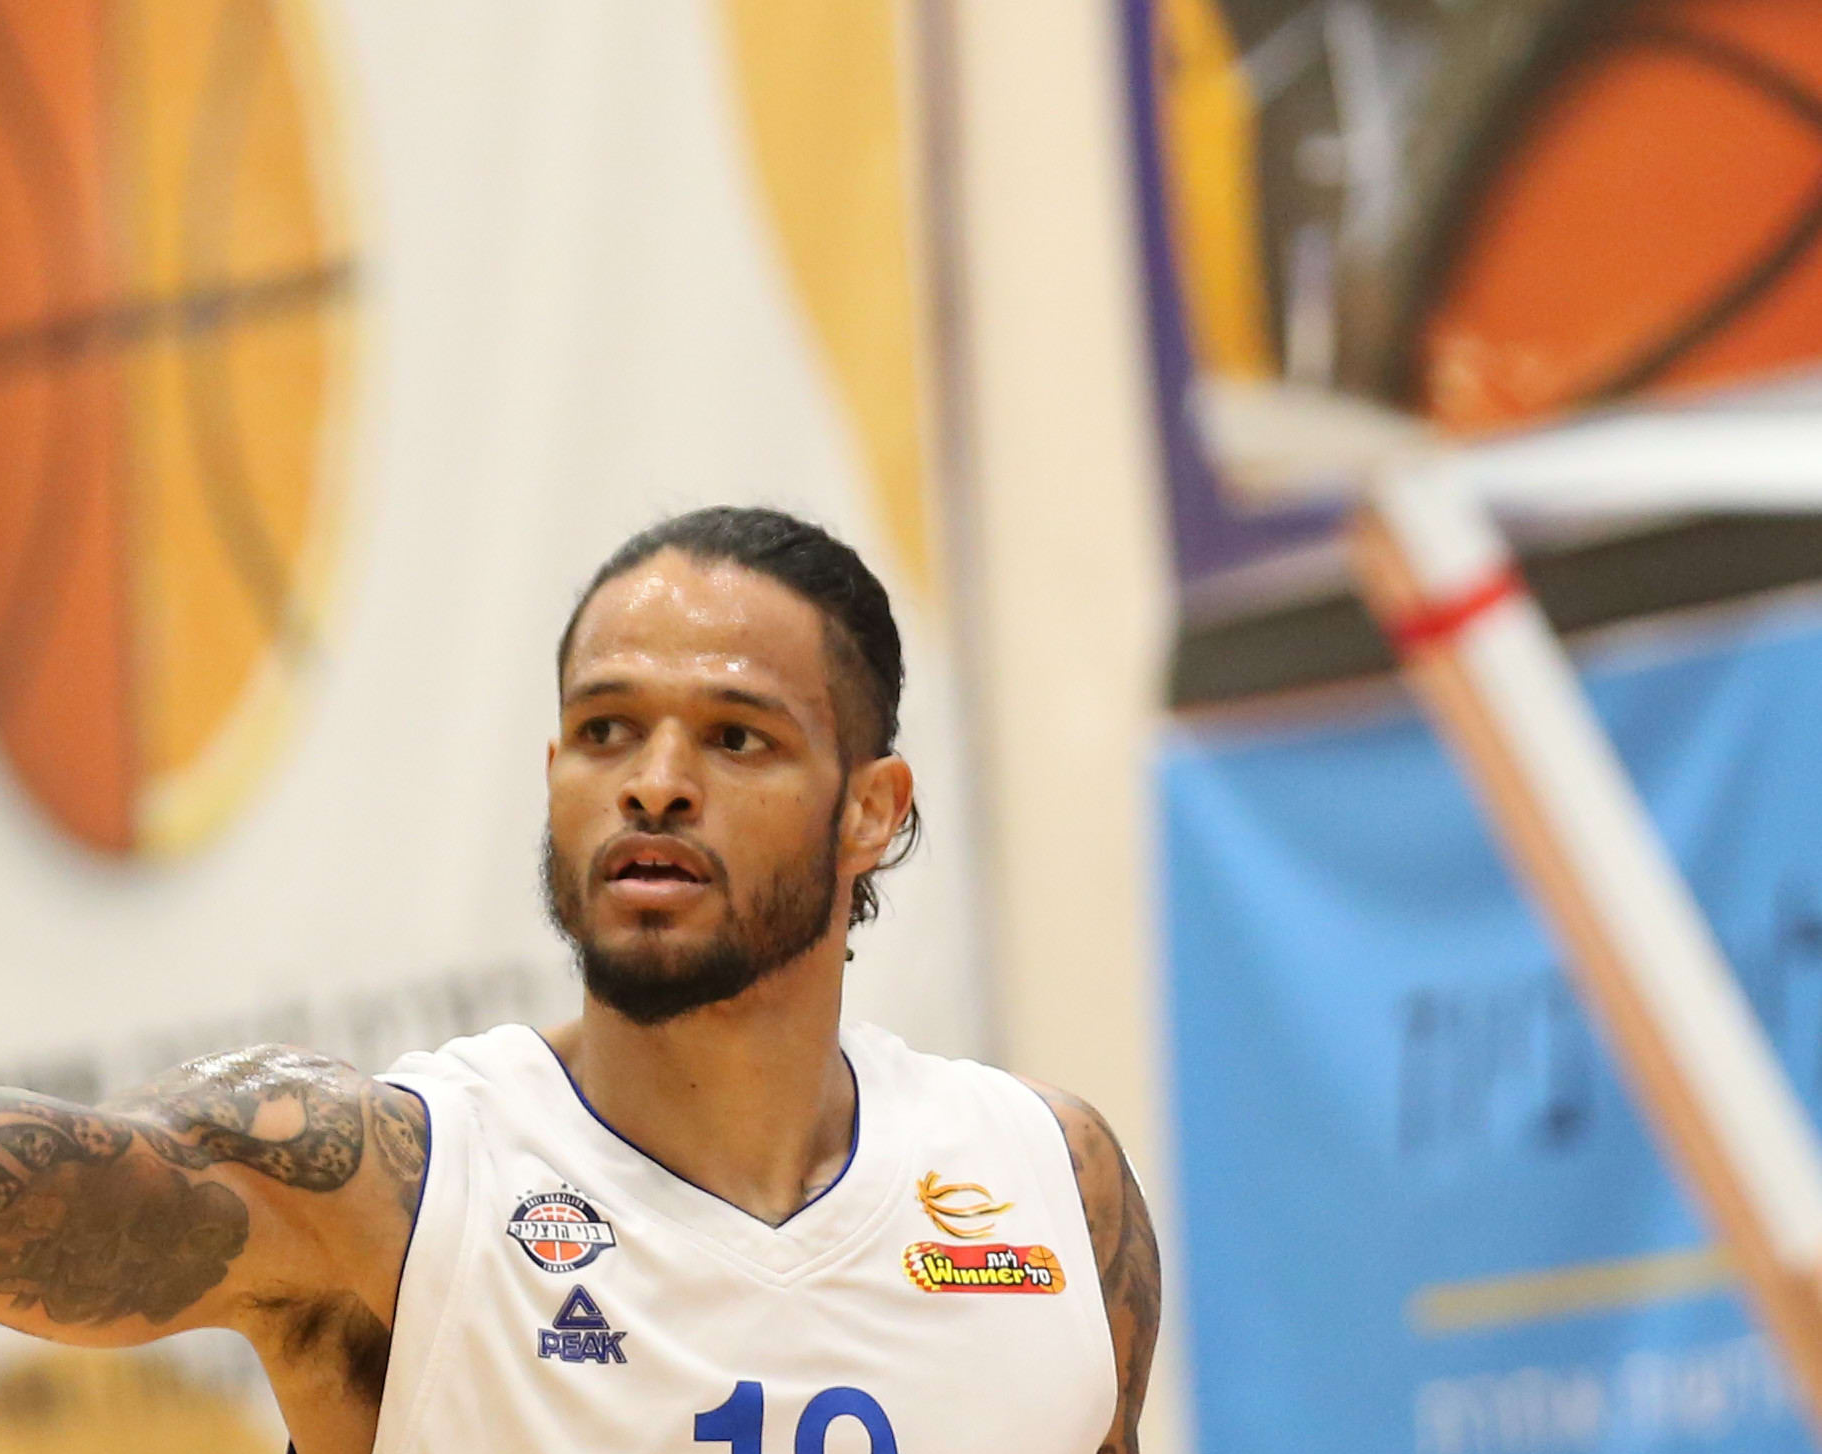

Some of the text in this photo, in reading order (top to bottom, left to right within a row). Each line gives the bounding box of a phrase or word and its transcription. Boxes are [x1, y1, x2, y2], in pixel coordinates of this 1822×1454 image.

[515, 1223, 602, 1240] בני הרצליה
[923, 1255, 1025, 1285] Winner
[1024, 1264, 1051, 1285] סל
[538, 1328, 628, 1364] PEAK
